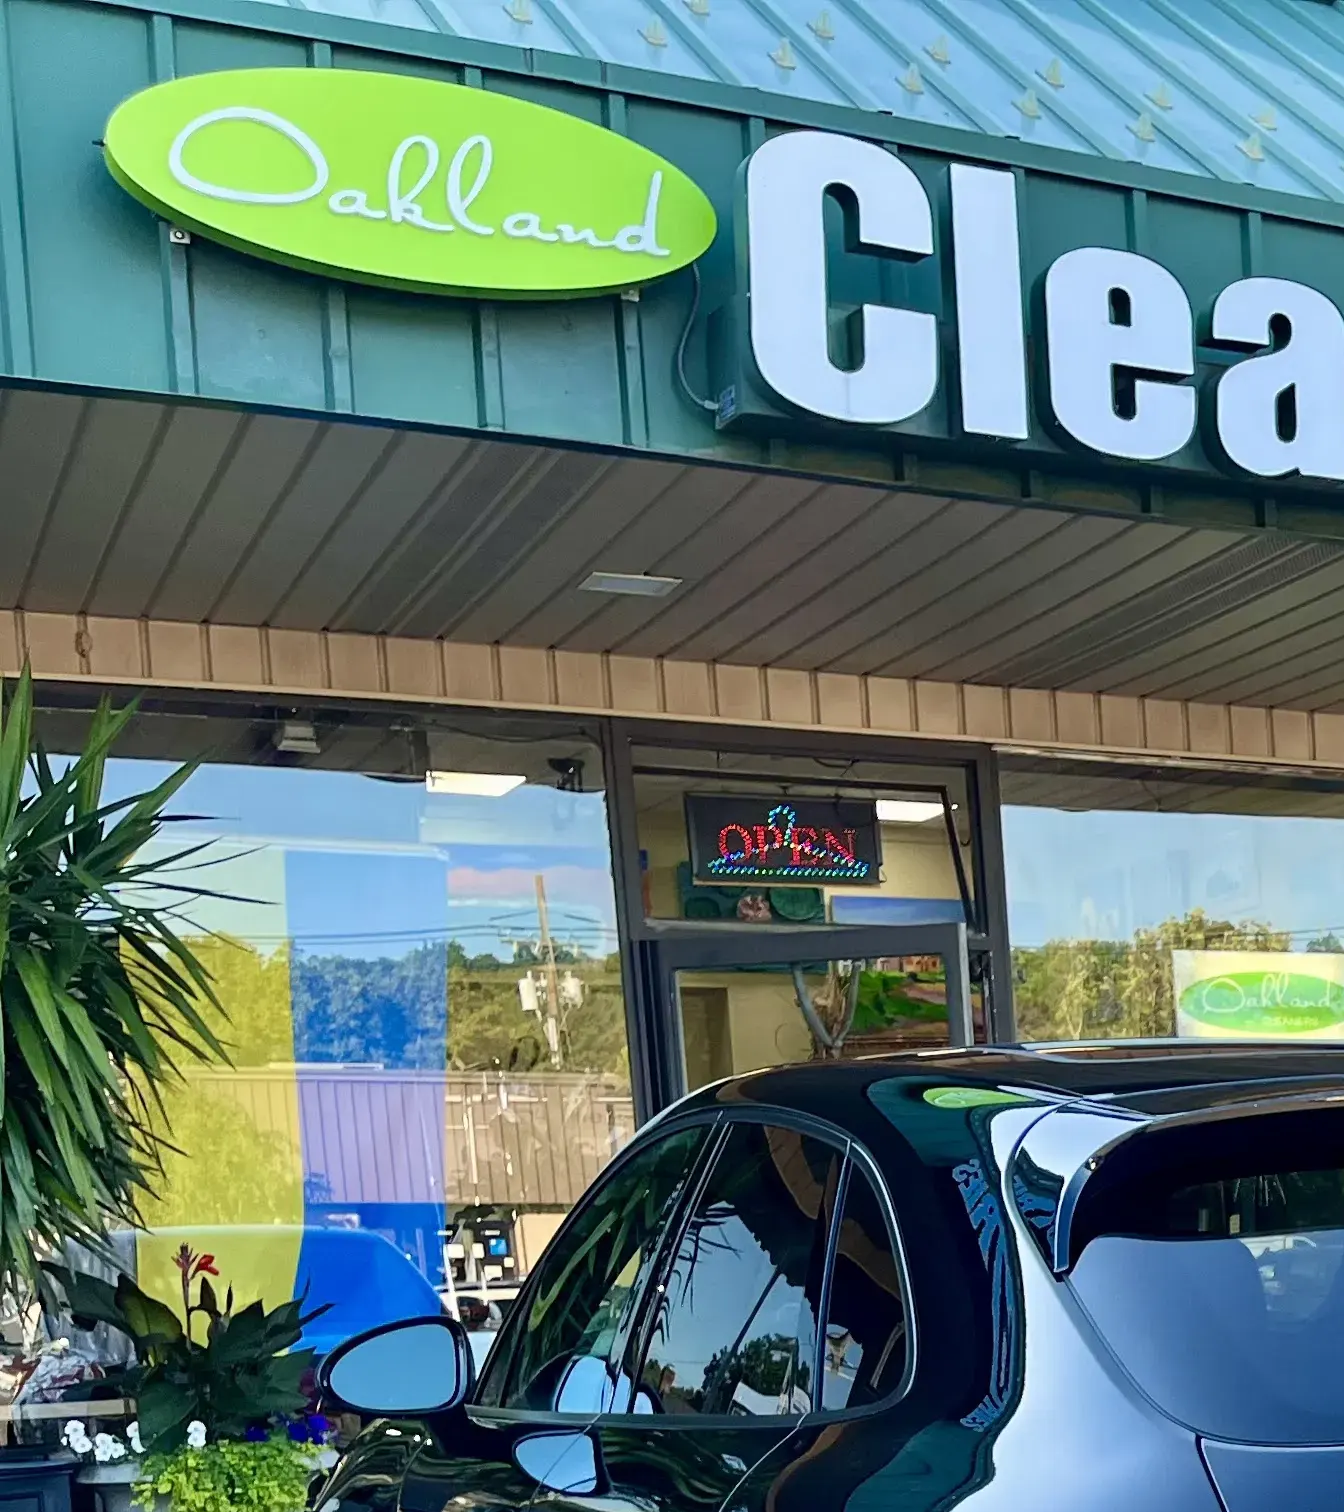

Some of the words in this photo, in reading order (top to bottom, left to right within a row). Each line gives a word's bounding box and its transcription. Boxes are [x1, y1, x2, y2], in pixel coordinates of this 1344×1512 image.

[168, 106, 671, 257] Oakland
[717, 823, 857, 867] OPEN
[1202, 972, 1331, 1014] Oakland
